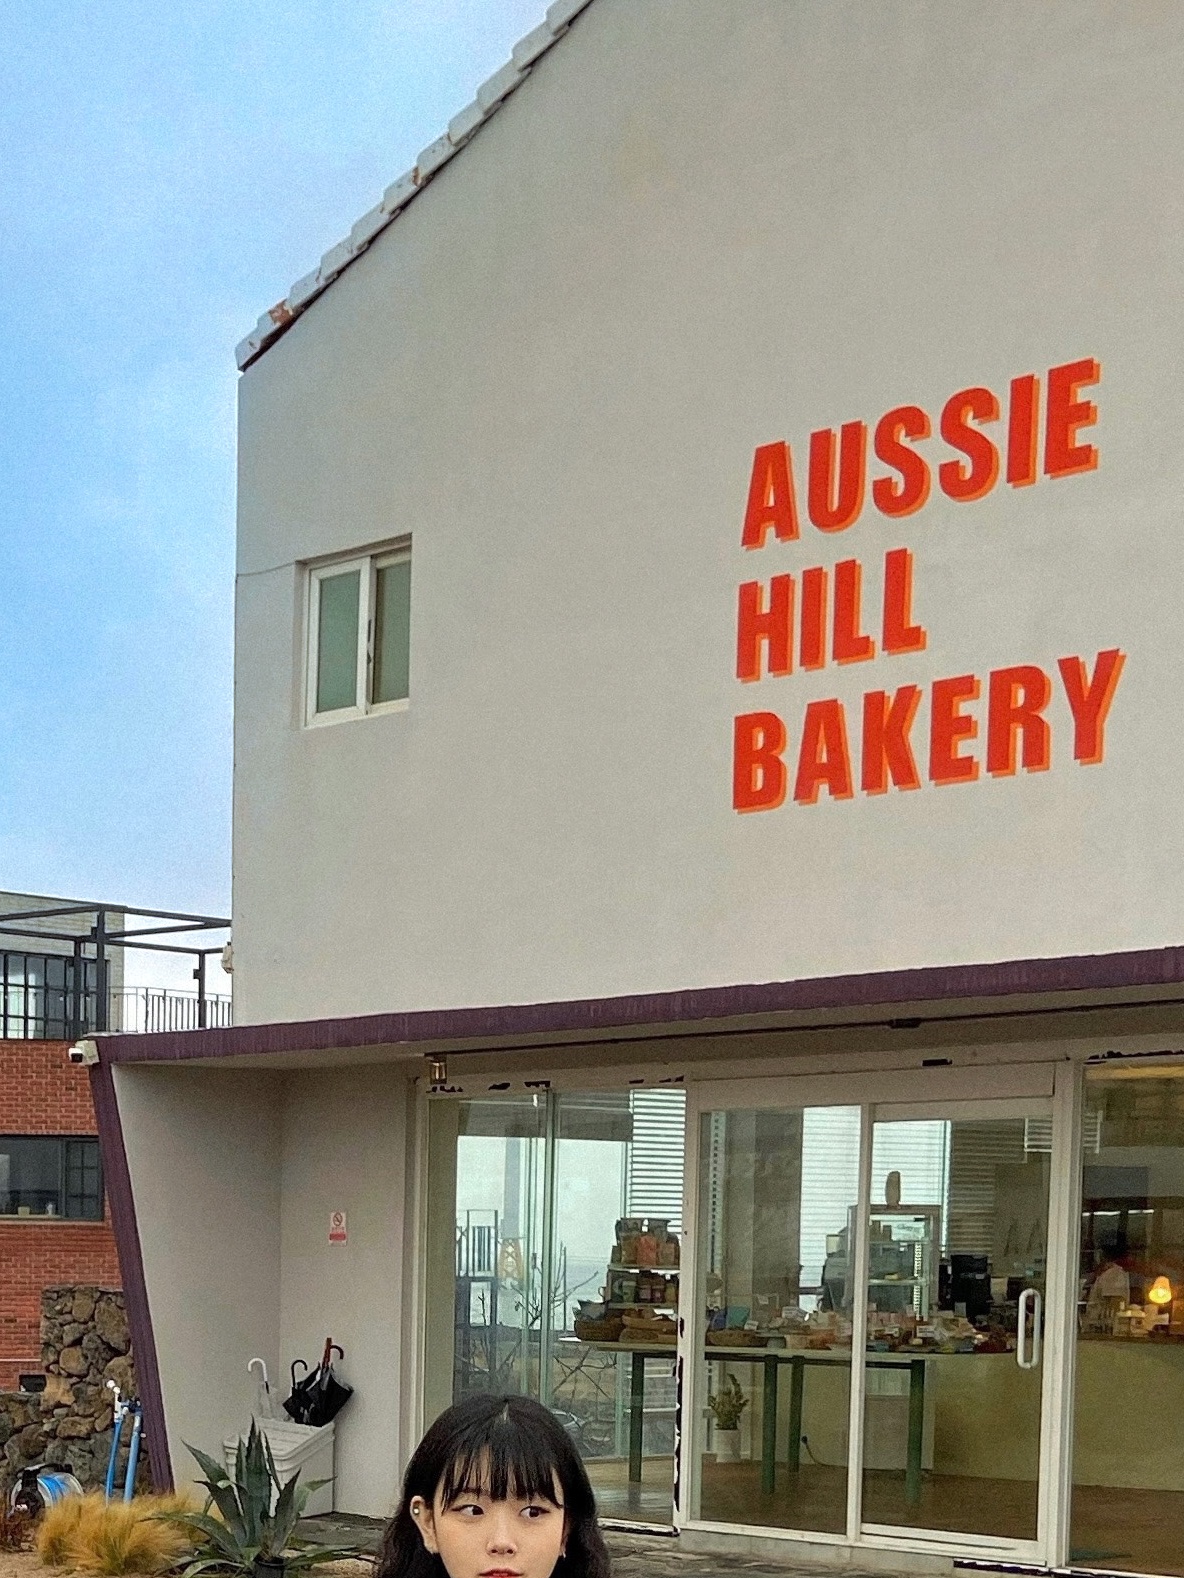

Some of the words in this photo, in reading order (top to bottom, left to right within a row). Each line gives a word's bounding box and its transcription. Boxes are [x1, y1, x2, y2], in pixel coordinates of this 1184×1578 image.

[741, 357, 1100, 551] AUSSIE
[736, 547, 926, 684] HILL
[732, 648, 1126, 815] BAKERY
